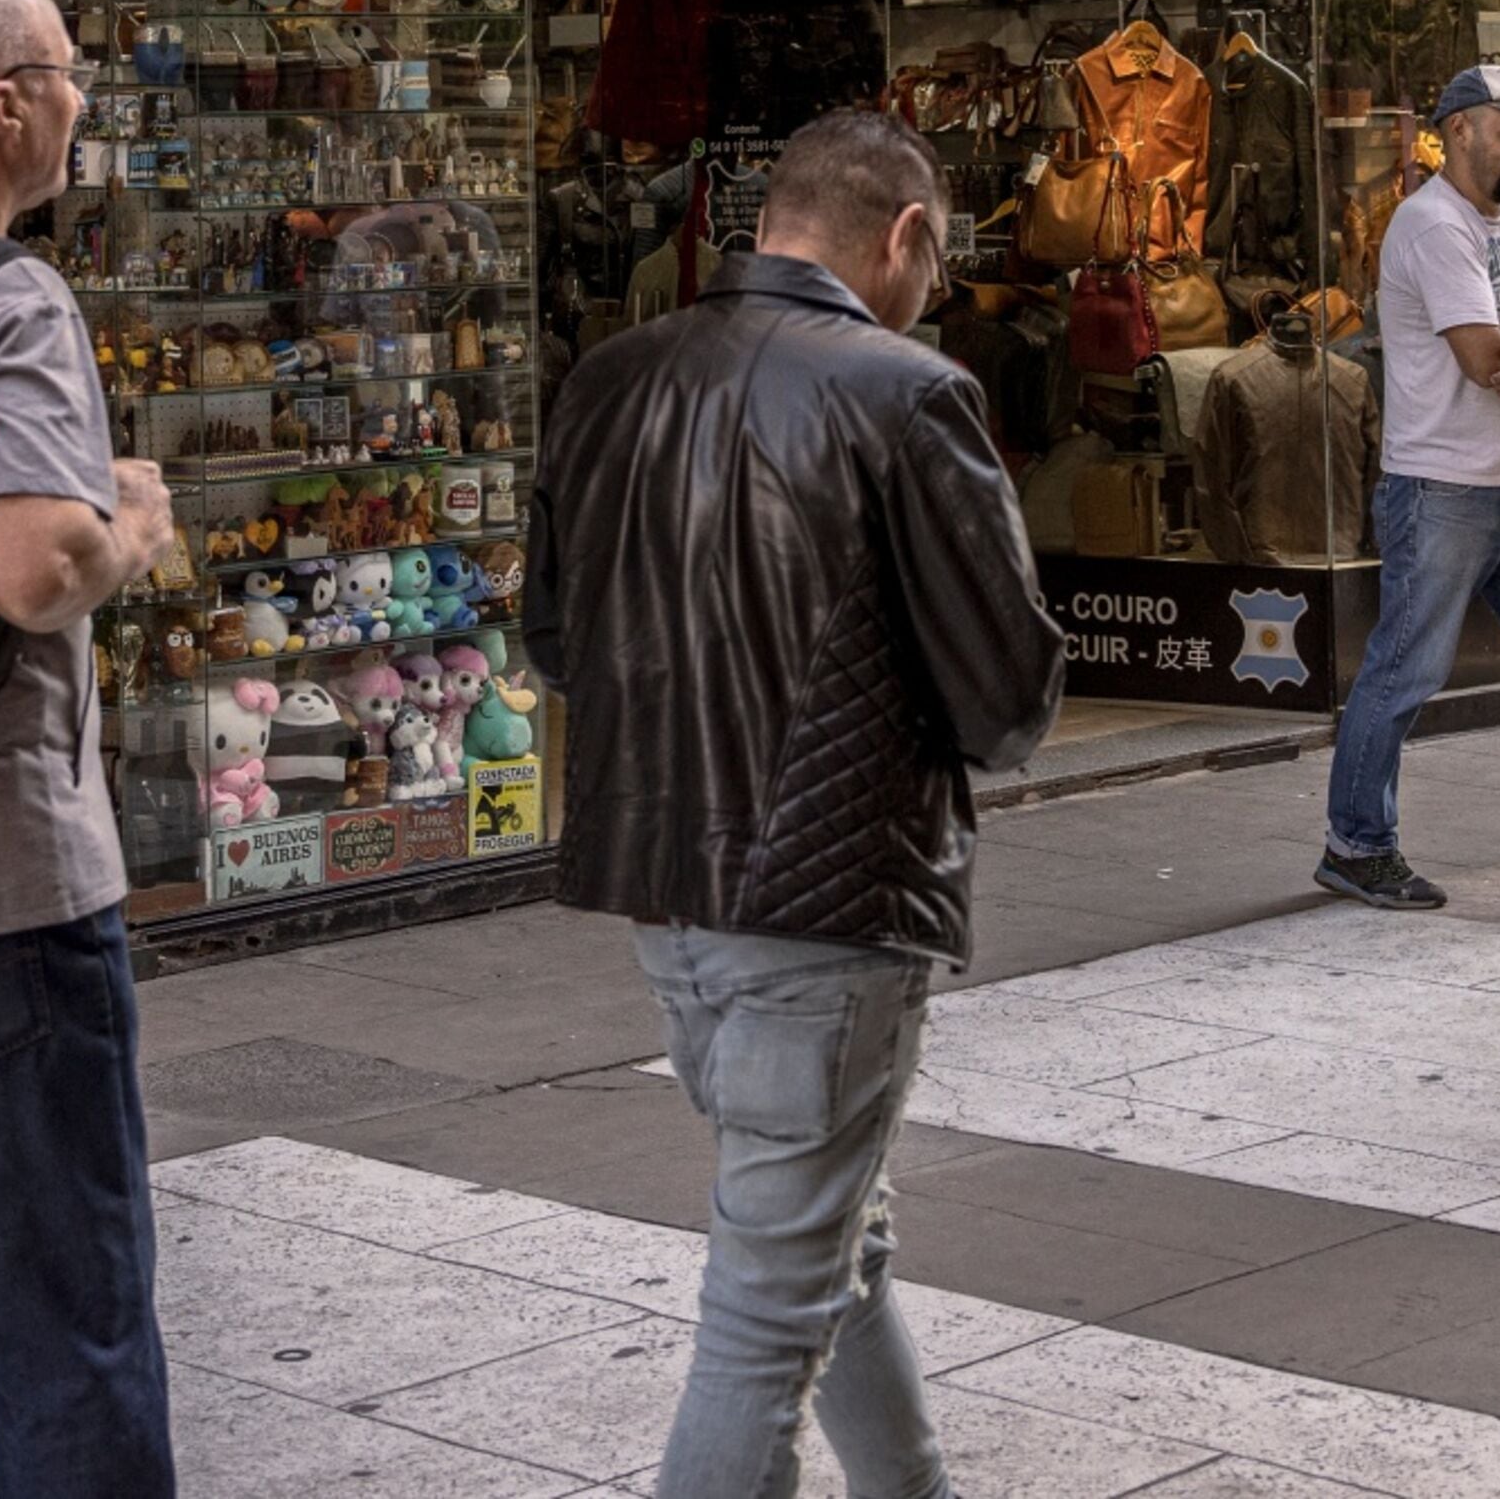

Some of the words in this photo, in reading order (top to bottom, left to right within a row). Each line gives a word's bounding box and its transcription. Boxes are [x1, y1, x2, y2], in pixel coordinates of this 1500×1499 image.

[1072, 592, 1178, 625] COURO
[1064, 634, 1130, 664] CUIR
[1155, 635, 1213, 672] 皮革
[253, 826, 319, 851] BUENOS
[475, 833, 534, 850] PROSEGUR
[216, 844, 225, 868] I
[261, 844, 313, 866] AIRES
